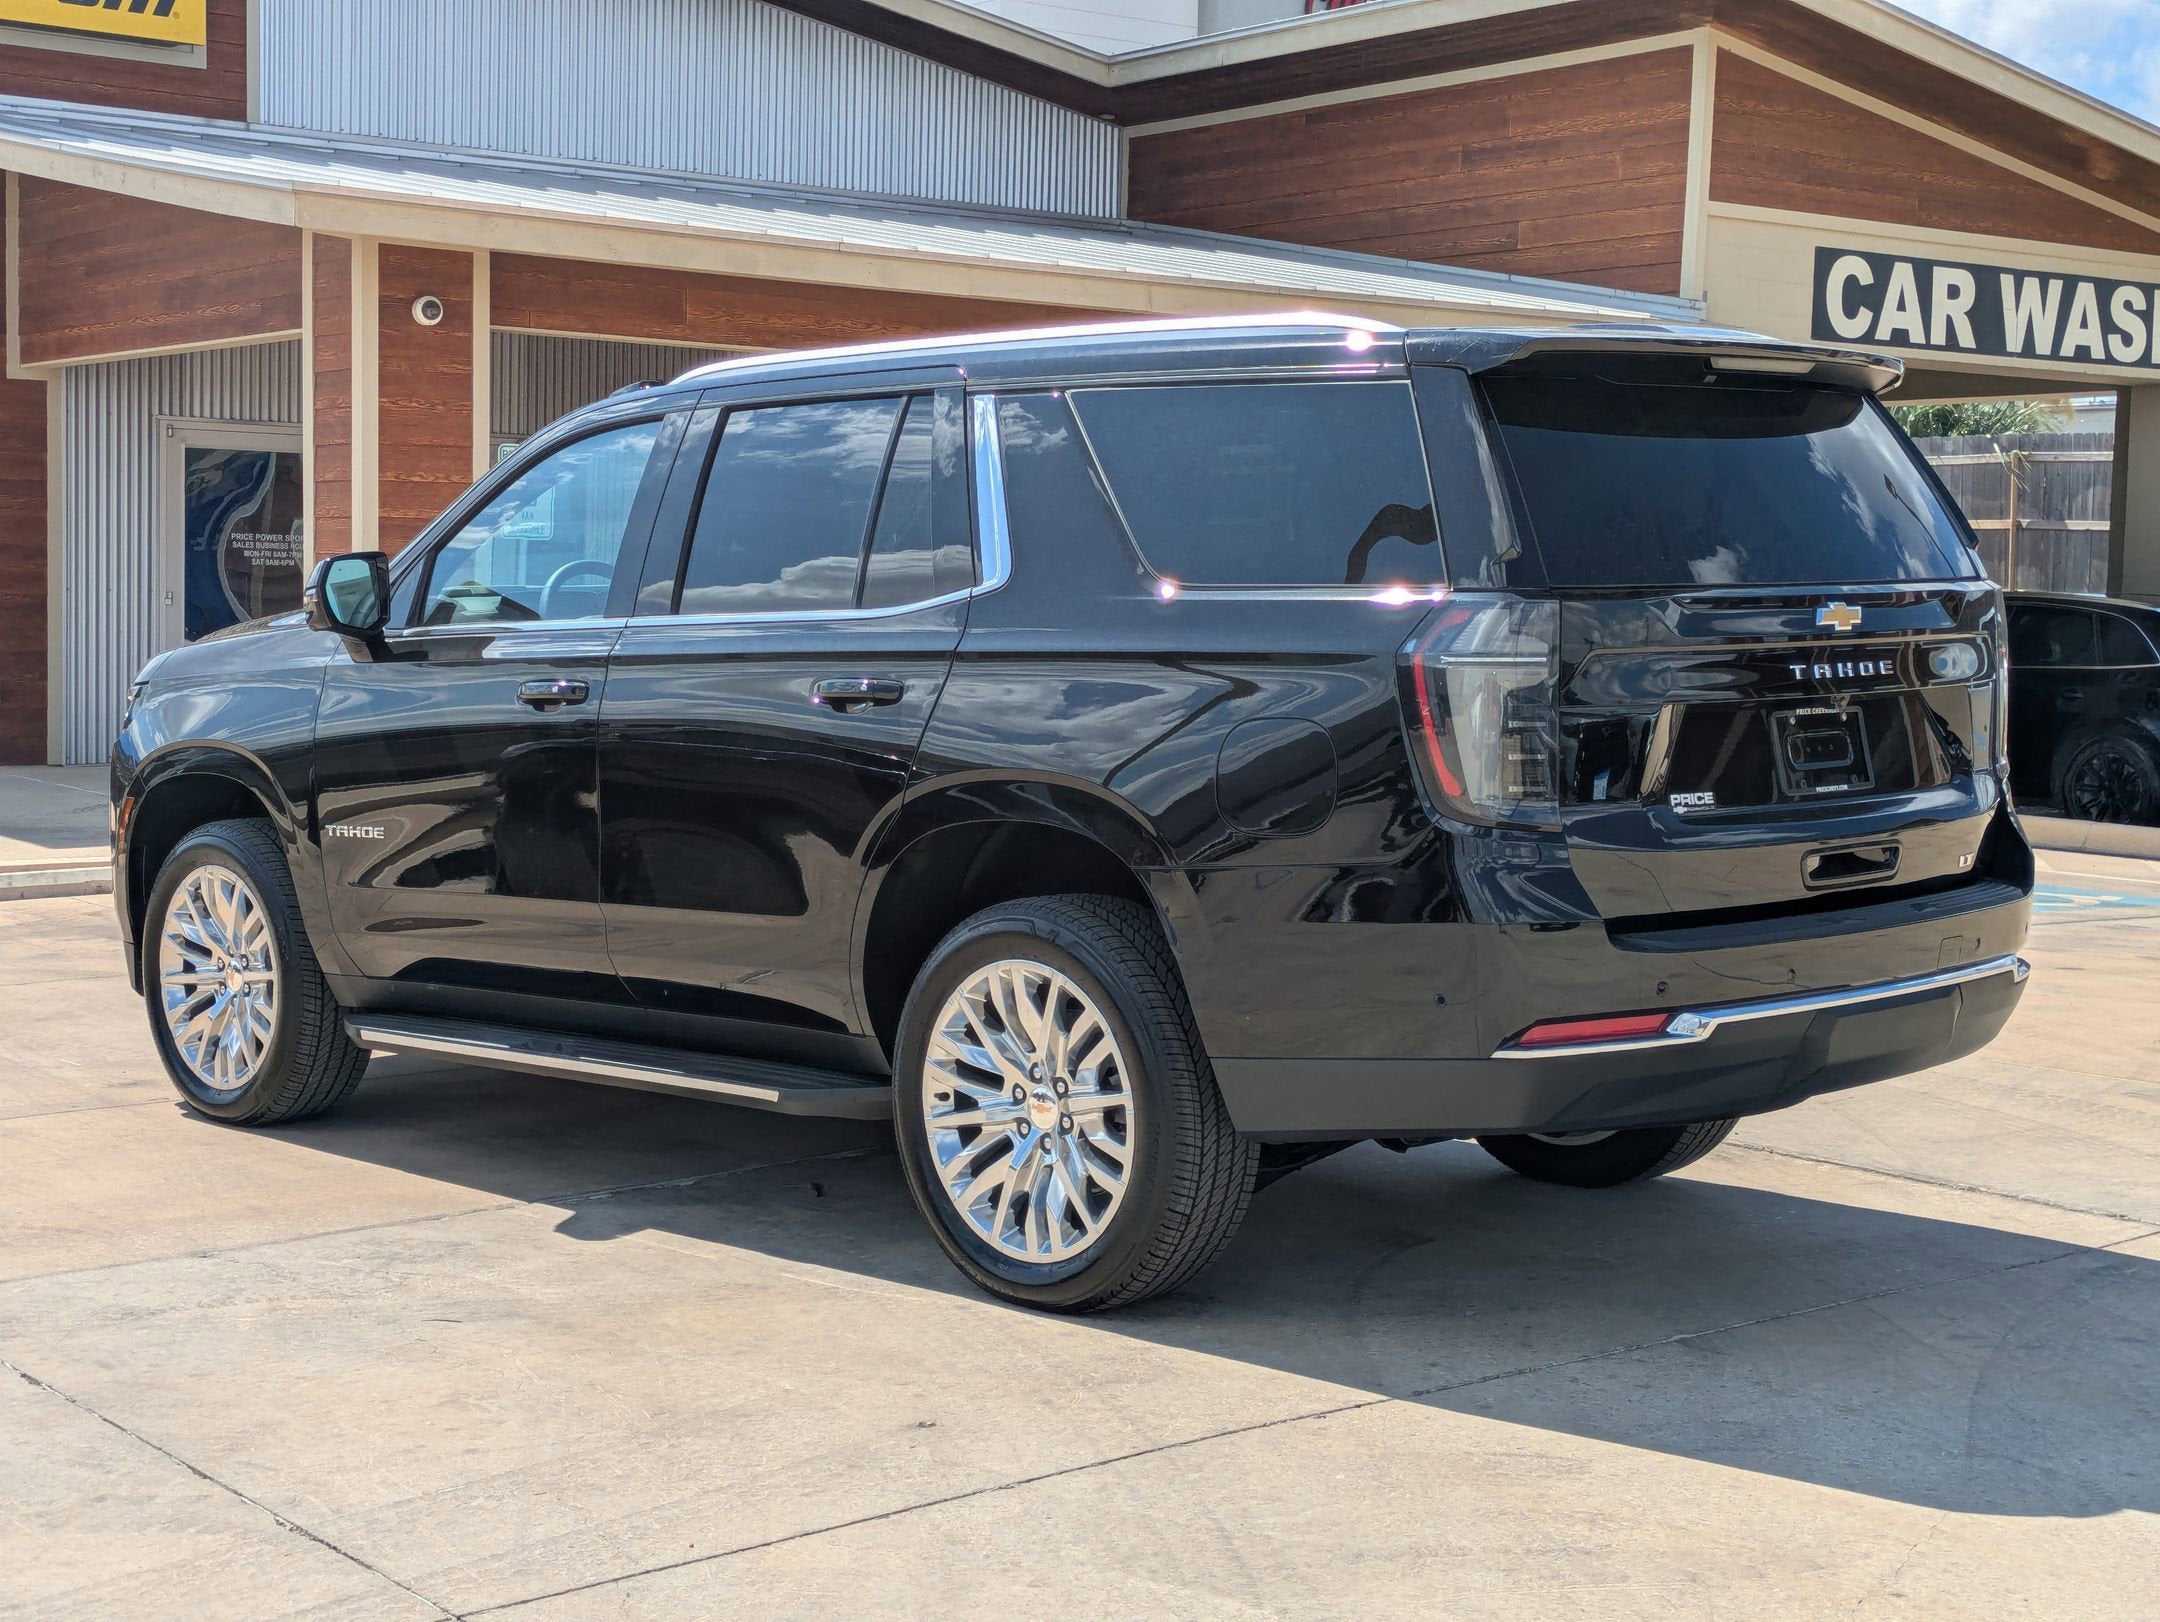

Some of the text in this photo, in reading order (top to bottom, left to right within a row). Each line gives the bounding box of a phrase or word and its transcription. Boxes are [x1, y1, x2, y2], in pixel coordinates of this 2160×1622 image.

[1826, 255, 2160, 364] CAR WAS
[231, 533, 254, 541] PRICE
[255, 533, 283, 542] POWER
[232, 541, 254, 549] SALES
[256, 541, 289, 550] BUSINESS
[244, 550, 272, 558] MON-FRI
[251, 558, 265, 566] SAT
[1789, 660, 1895, 680] TAHOE
[1670, 791, 1715, 806] PRICE
[325, 824, 385, 839] TAHOE
[1959, 853, 1975, 868] LT
